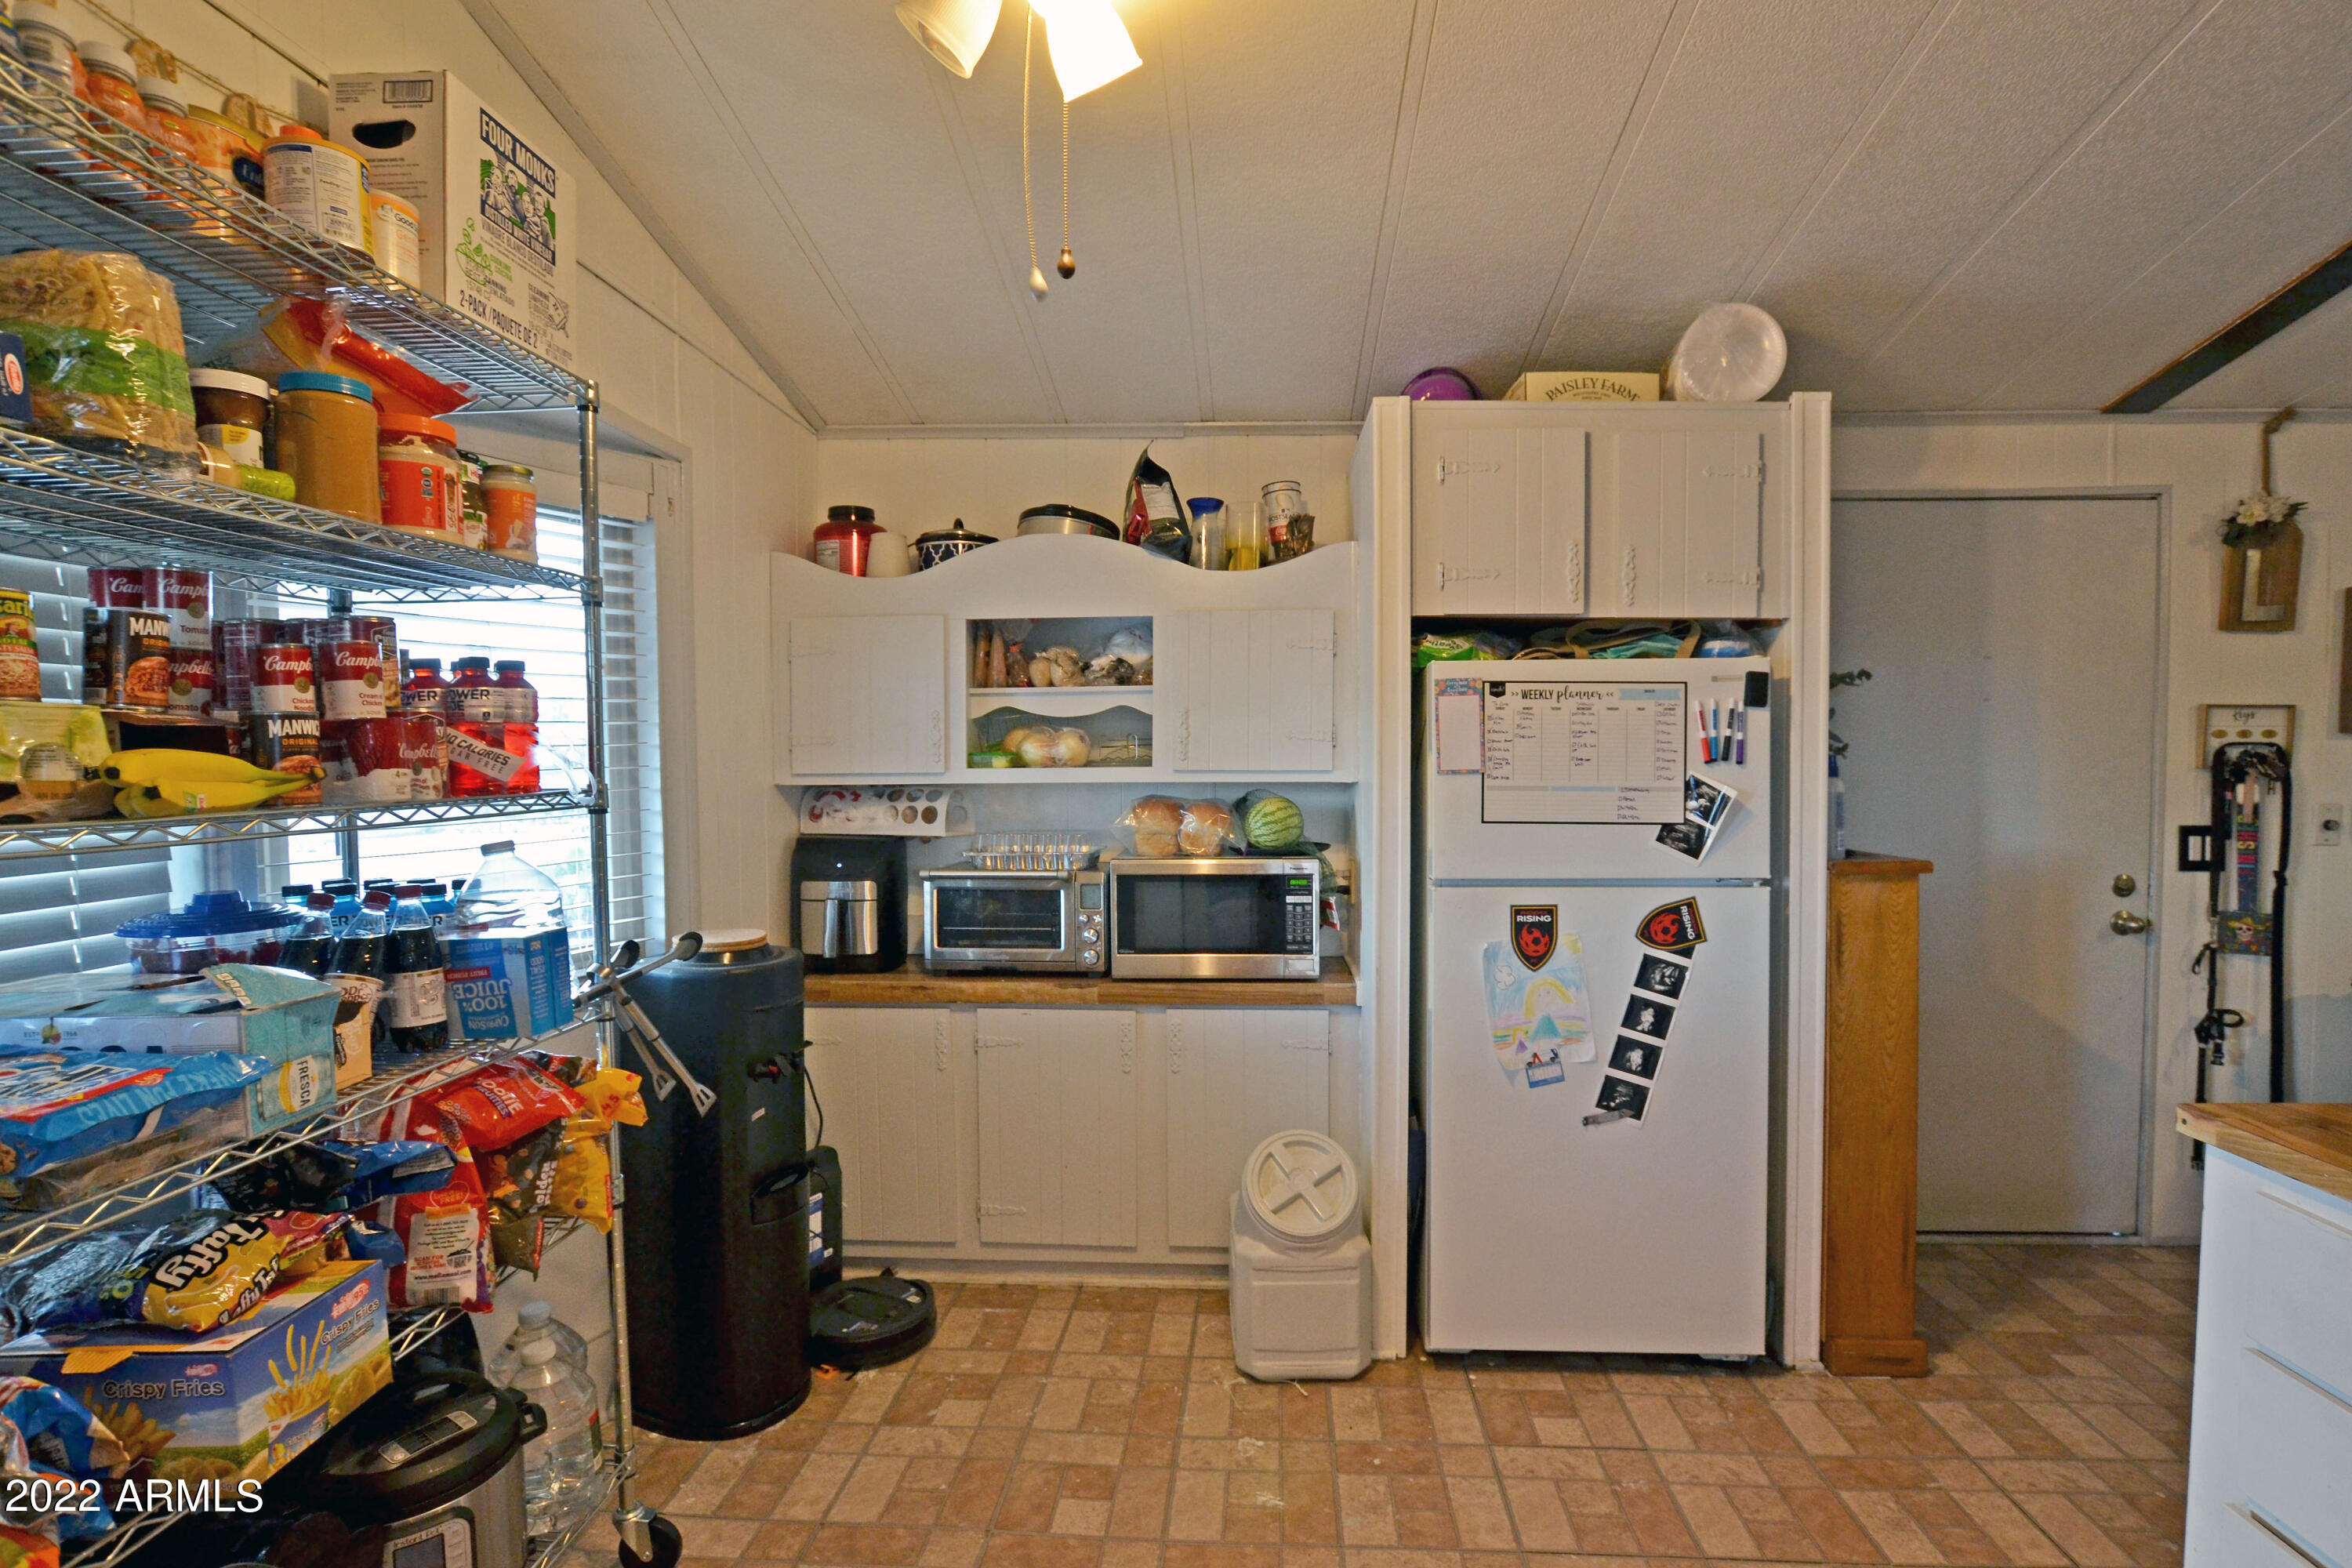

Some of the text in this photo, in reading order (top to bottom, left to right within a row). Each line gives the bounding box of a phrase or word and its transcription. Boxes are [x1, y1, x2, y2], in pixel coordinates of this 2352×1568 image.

[481, 117, 556, 195] FOUR MONKS
[523, 325, 533, 345] DE
[532, 332, 539, 350] 2
[1545, 377, 1599, 401] PAISLEY
[1600, 378, 1639, 402] FARM
[2241, 550, 2285, 622] L
[1520, 684, 1604, 703] WEEKLY planner
[456, 739, 512, 767] CALORIES
[1680, 905, 1696, 940] RISING
[452, 978, 512, 1000] JUICE
[463, 995, 507, 1012] 100%
[298, 1058, 310, 1108] FRESCA
[321, 1316, 354, 1345] Crispy
[354, 1298, 379, 1323] Fries
[102, 1378, 225, 1400] Crispy Fries
